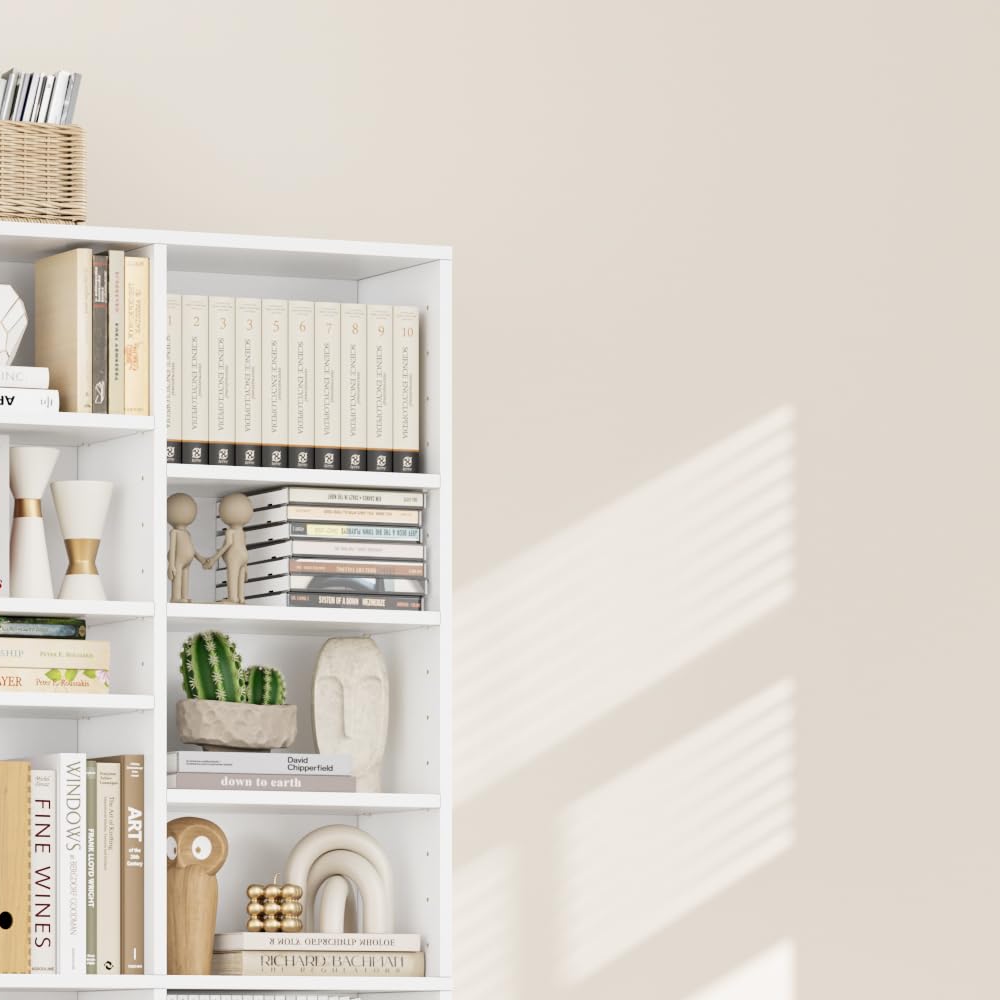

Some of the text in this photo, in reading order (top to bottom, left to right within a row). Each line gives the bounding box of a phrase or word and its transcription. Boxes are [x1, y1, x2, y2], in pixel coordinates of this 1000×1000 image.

[193, 316, 200, 327] 2
[352, 322, 359, 336] 8
[378, 325, 385, 337] 9
[402, 327, 414, 338] 10
[287, 764, 334, 772] Chipperfield
[220, 776, 302, 788] down to earth
[65, 761, 81, 851] WINDOWS
[127, 807, 142, 842] ART
[34, 799, 51, 948] FINE WINES
[87, 828, 95, 908] FRANK LLOYD WRIGHT
[260, 955, 326, 967] RICHARD
